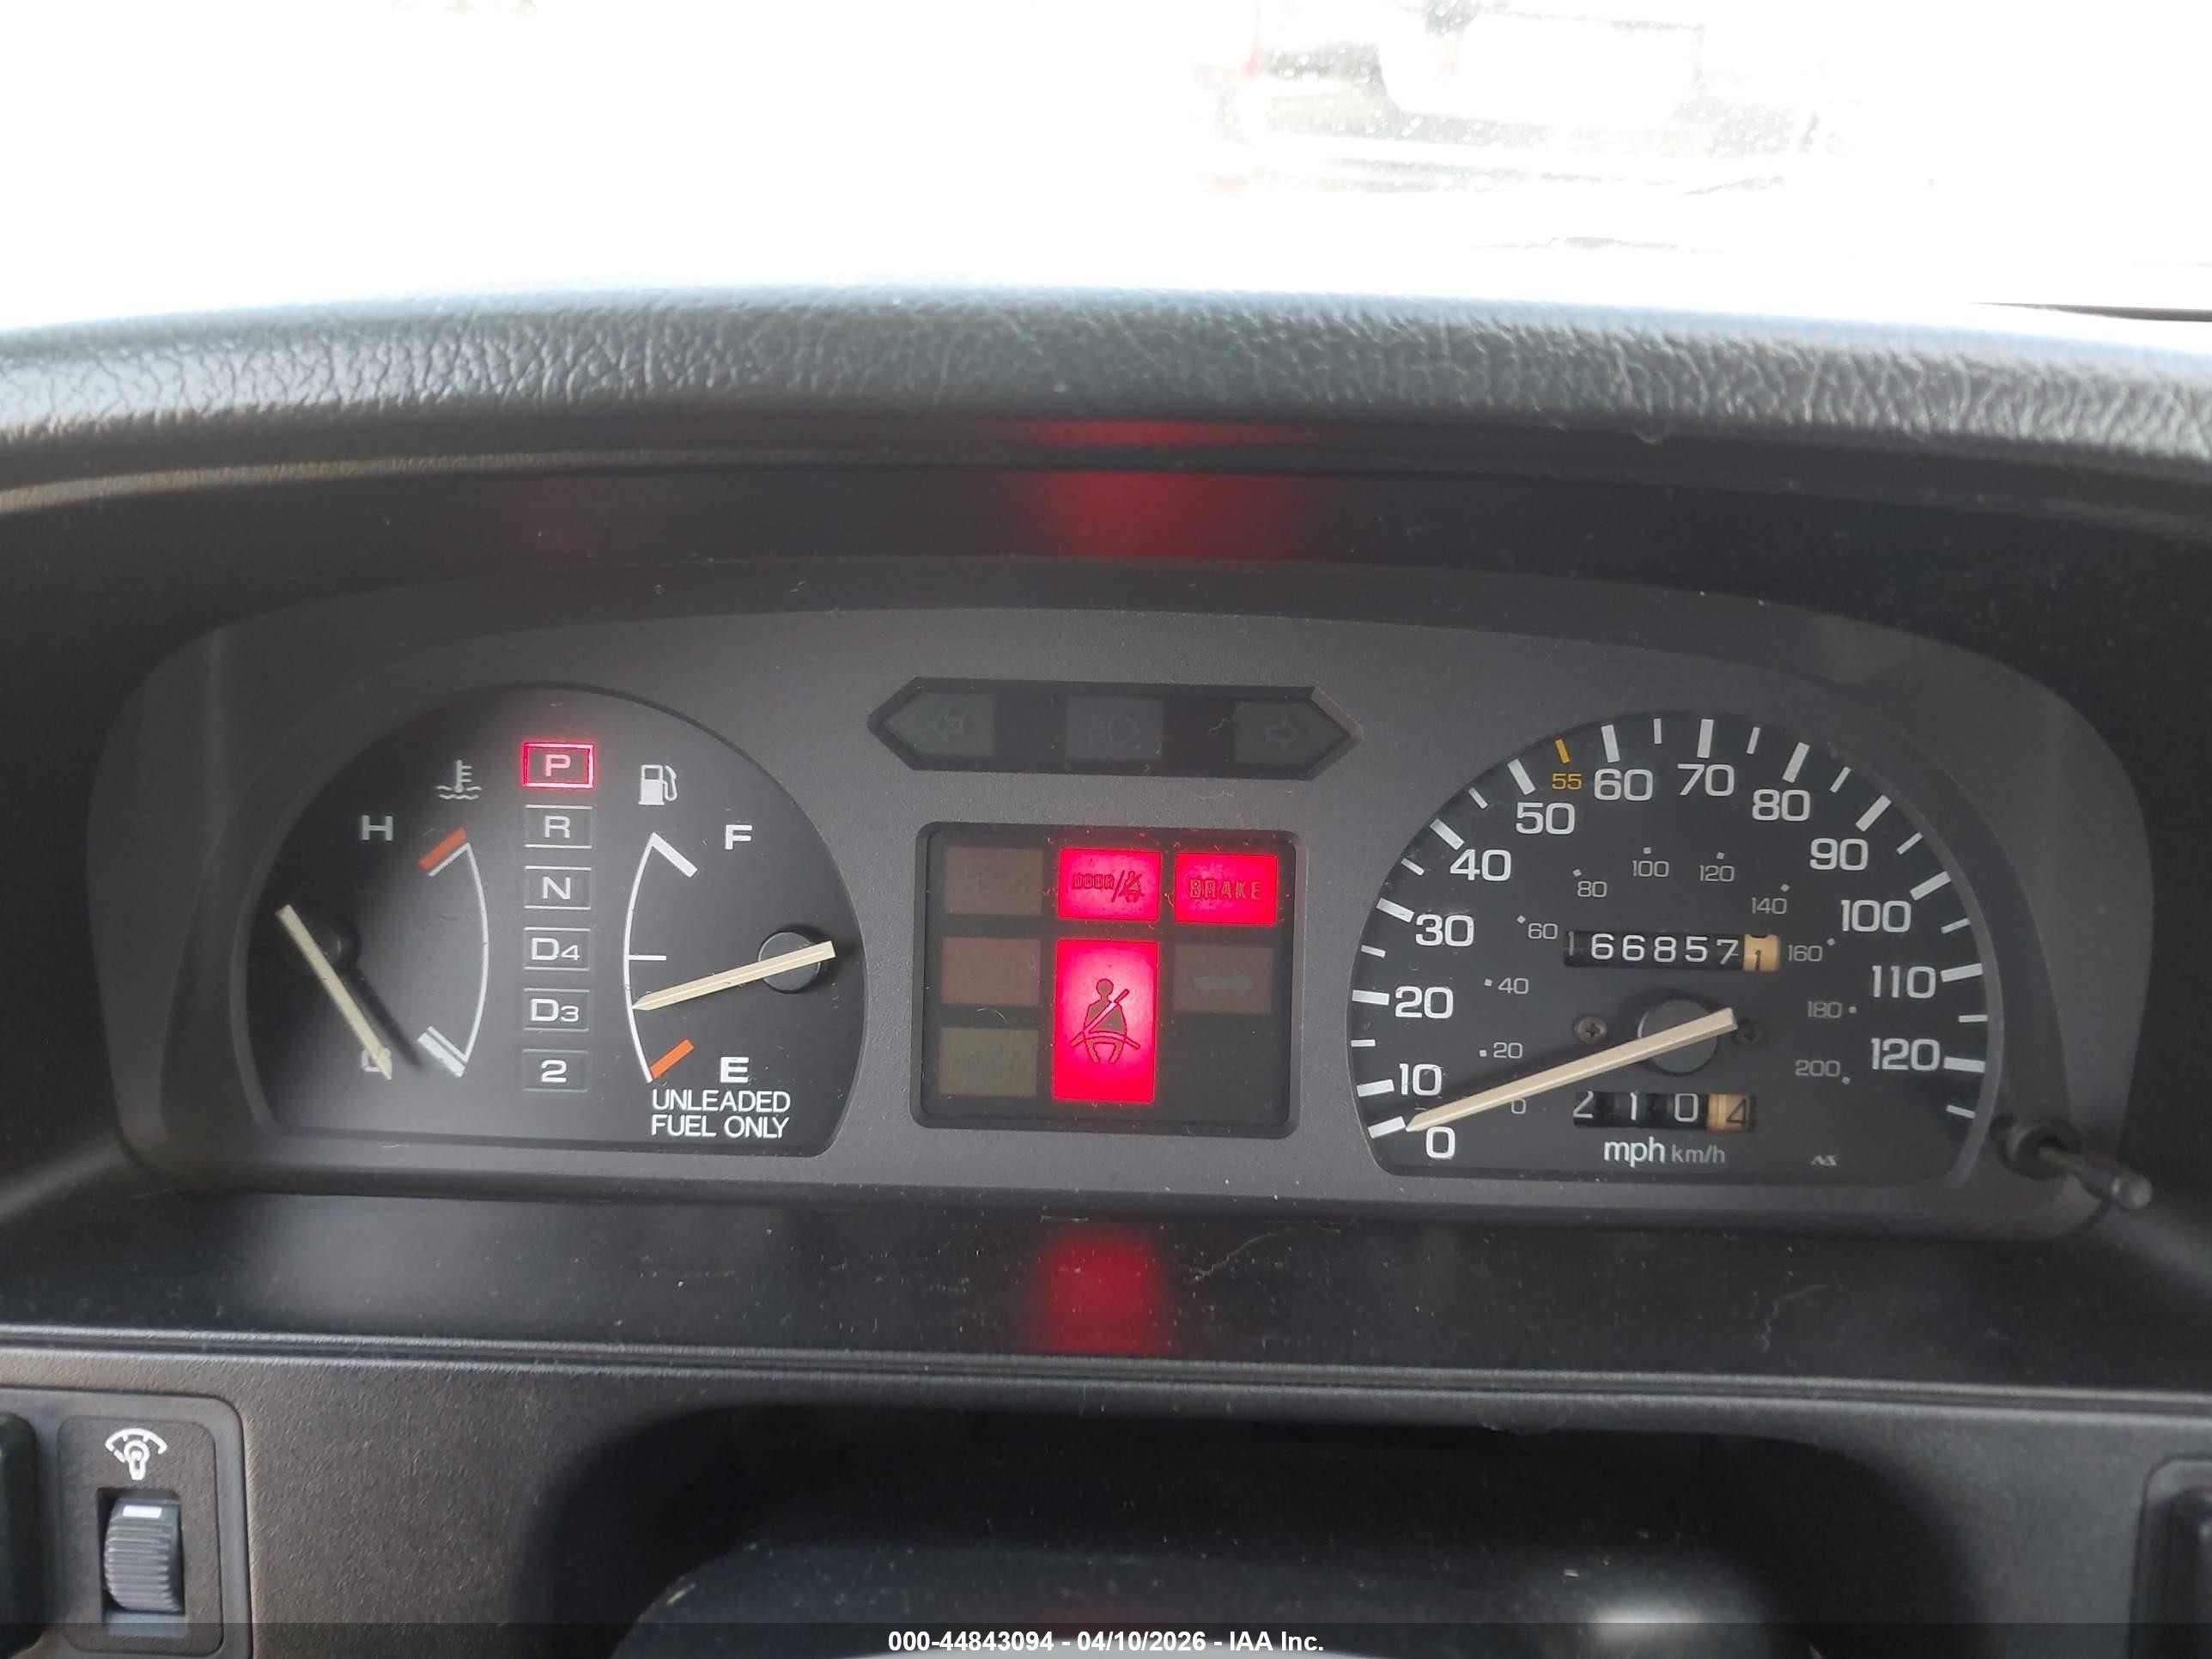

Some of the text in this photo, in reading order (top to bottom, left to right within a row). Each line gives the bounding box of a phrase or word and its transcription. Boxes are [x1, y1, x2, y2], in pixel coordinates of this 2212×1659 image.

[545, 755, 570, 776] P
[1553, 774, 1581, 789] 55
[1595, 769, 1652, 800] 60
[1678, 764, 1734, 796] 70
[1753, 789, 1810, 821] 80
[362, 816, 392, 841] H
[545, 816, 570, 838] R
[1516, 802, 1575, 834] 50
[726, 825, 752, 849] F
[1450, 849, 1511, 881] 40
[1810, 838, 1868, 870] 90
[1632, 860, 1668, 877] 100
[1700, 866, 1734, 881] 120
[543, 877, 570, 899] N
[1188, 878, 1261, 901] BRAKE
[1577, 881, 1607, 897] 80
[1752, 897, 1787, 914] 140
[1841, 900, 1911, 932] 100
[1416, 915, 1474, 946] 30
[1528, 923, 1558, 939] 60
[532, 938, 580, 960] D4
[1789, 945, 1822, 962] 160
[1498, 978, 1528, 994] 40
[1873, 966, 1936, 998] 110
[532, 999, 578, 1022] D3
[1395, 986, 1453, 1018] 20
[1808, 1001, 1842, 1018] 180
[1493, 1042, 1522, 1058] 20
[1871, 1038, 1940, 1070] 120
[542, 1060, 566, 1082] 2
[720, 1057, 749, 1083] E
[1400, 1064, 1442, 1095] 10
[1796, 1060, 1840, 1077] 200
[653, 1089, 790, 1112] UNLEADED
[652, 1115, 789, 1138] FUEL ONLY
[1426, 1127, 1455, 1159] 0
[1604, 1137, 1724, 1168] mph km/h
